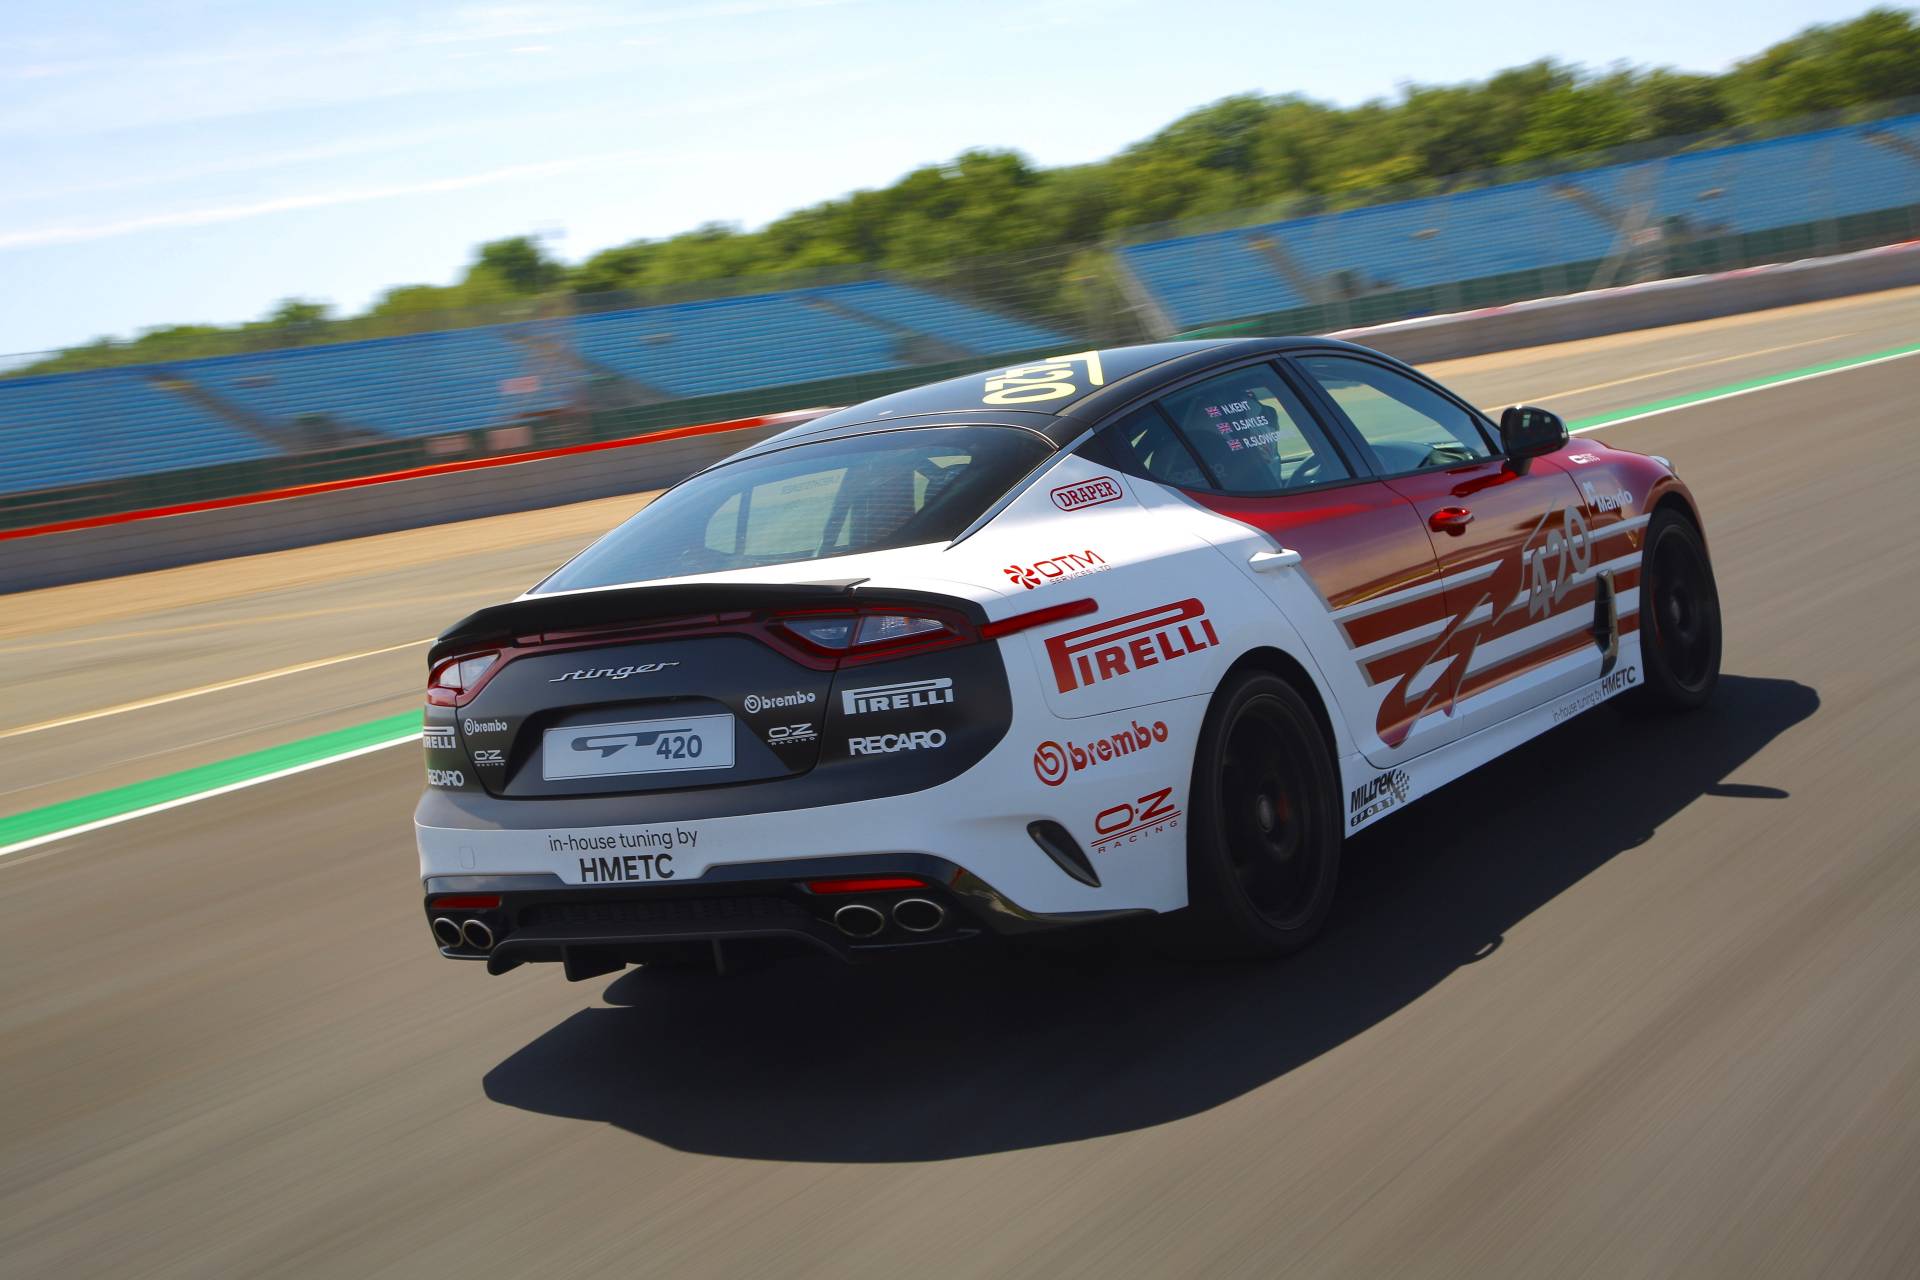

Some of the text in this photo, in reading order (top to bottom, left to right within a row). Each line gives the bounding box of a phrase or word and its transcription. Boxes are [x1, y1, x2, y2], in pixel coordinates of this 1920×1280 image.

[1221, 401, 1251, 415] N.KENT
[1232, 416, 1269, 431] D.SAYLES
[1057, 482, 1117, 507] DRAPER
[1597, 490, 1633, 513] Mando
[1033, 550, 1106, 577] OTM
[1528, 505, 1592, 619] 420
[1044, 597, 1220, 694] PIRELLI
[548, 661, 680, 682] stinger
[1601, 666, 1636, 696] HMETC
[762, 691, 816, 709] brembo
[841, 677, 954, 715] PIRELLI
[474, 720, 507, 732] brembo
[656, 735, 702, 759] 420
[848, 729, 947, 755] RECARO
[1067, 720, 1169, 771] brembo
[427, 768, 465, 787] RECARO
[549, 828, 698, 852] in-house tuning by
[1098, 820, 1178, 853] RACING
[579, 853, 675, 882] HMETC
